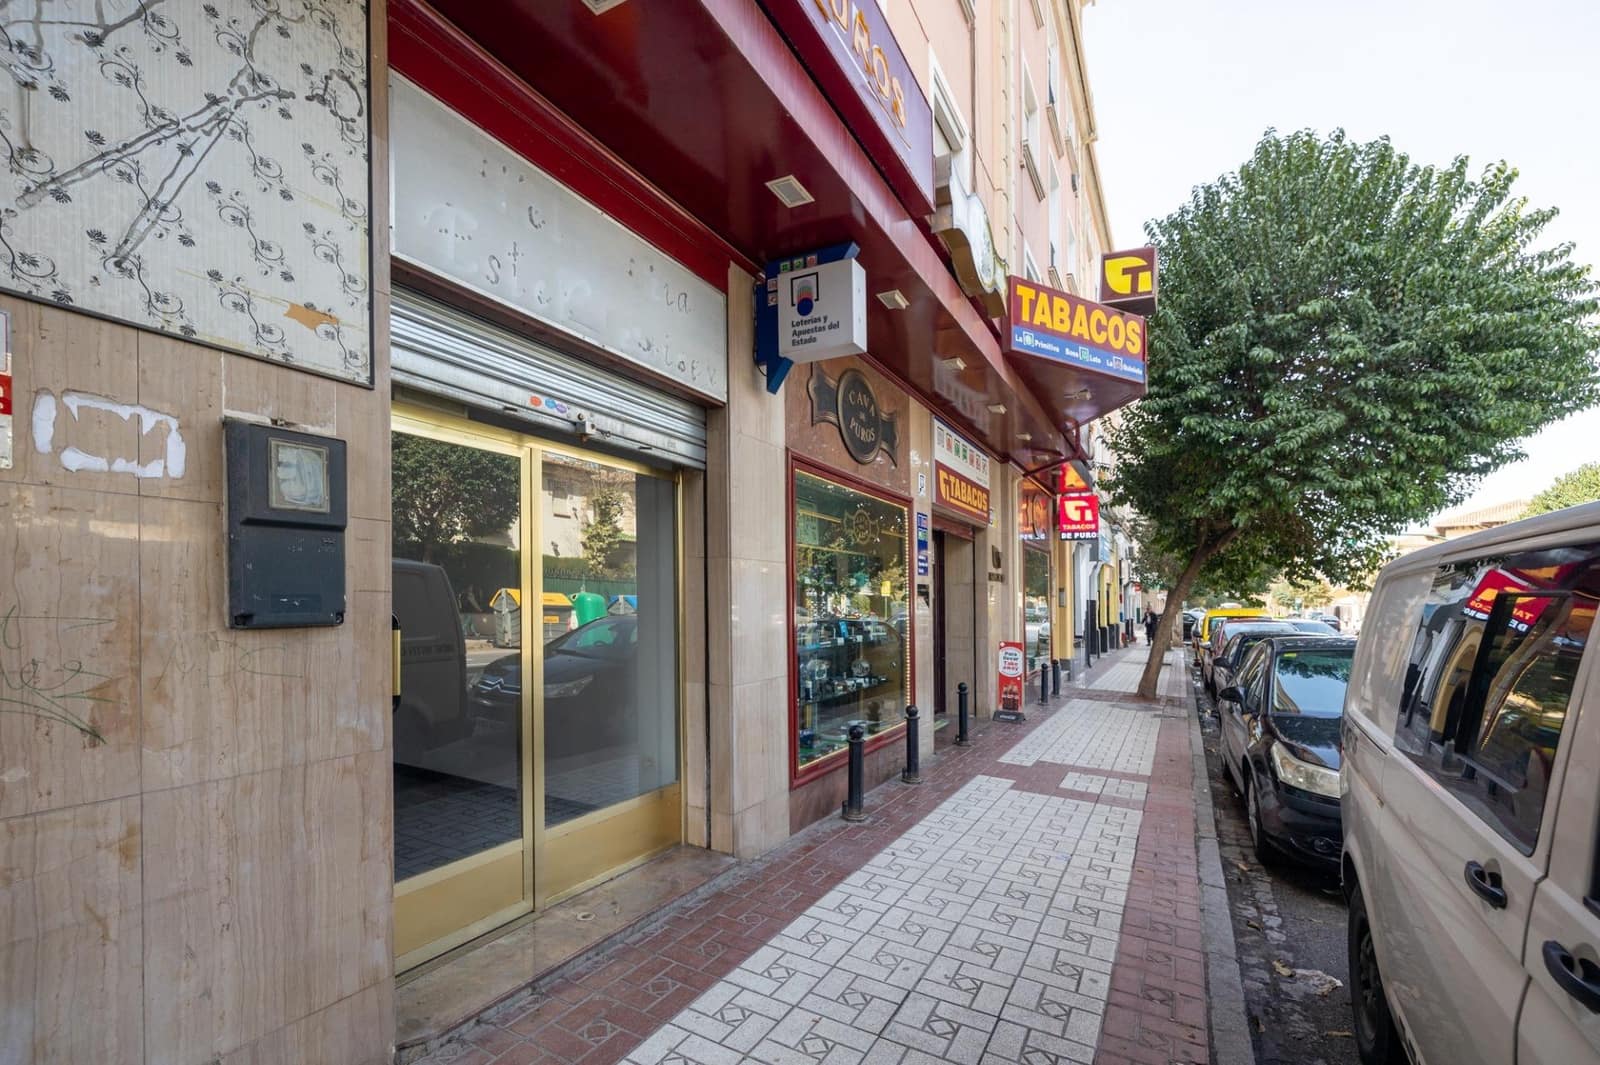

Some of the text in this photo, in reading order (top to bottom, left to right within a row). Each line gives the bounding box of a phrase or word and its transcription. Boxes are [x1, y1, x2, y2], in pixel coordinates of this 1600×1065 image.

[812, 0, 906, 129] UROS
[791, 321, 840, 338] Apuestas del
[1016, 284, 1141, 355] TABACOS
[791, 336, 817, 347] Estado
[849, 390, 875, 416] CAVA
[849, 416, 876, 442] PUROS
[949, 474, 988, 512] TABACOS
[1061, 531, 1097, 539] DE PURO
[1062, 523, 1096, 531] TABACOS
